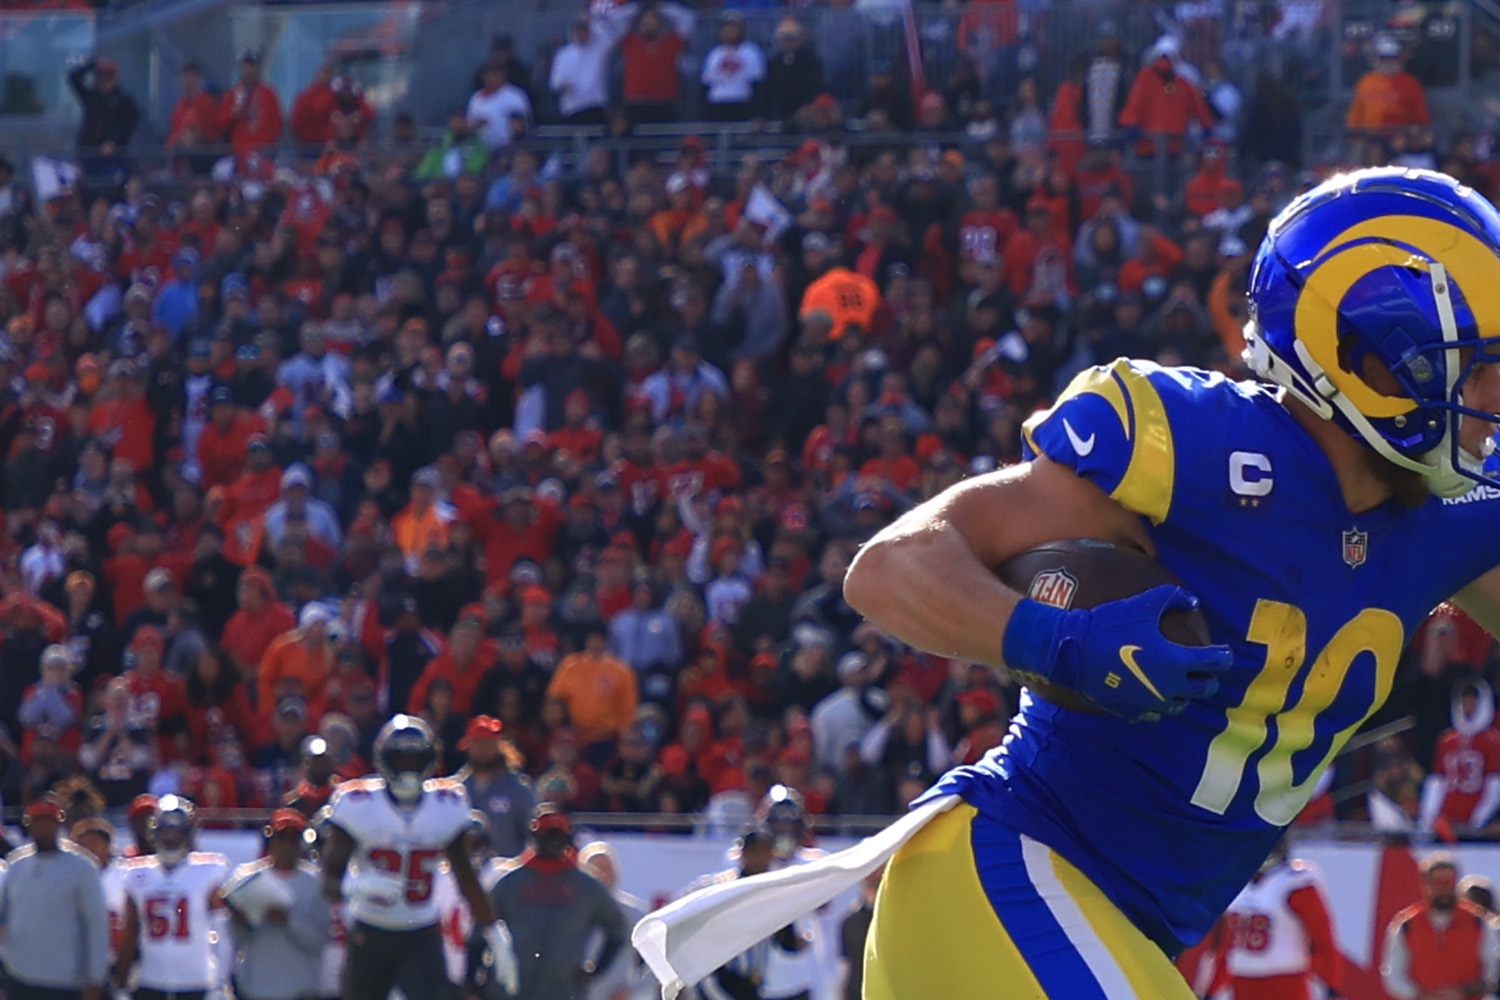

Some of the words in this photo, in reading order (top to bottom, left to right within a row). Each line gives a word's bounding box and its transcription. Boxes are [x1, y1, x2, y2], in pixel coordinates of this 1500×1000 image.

[1229, 450, 1274, 497] C
[1190, 598, 1404, 827] 10
[145, 897, 190, 938] 51
